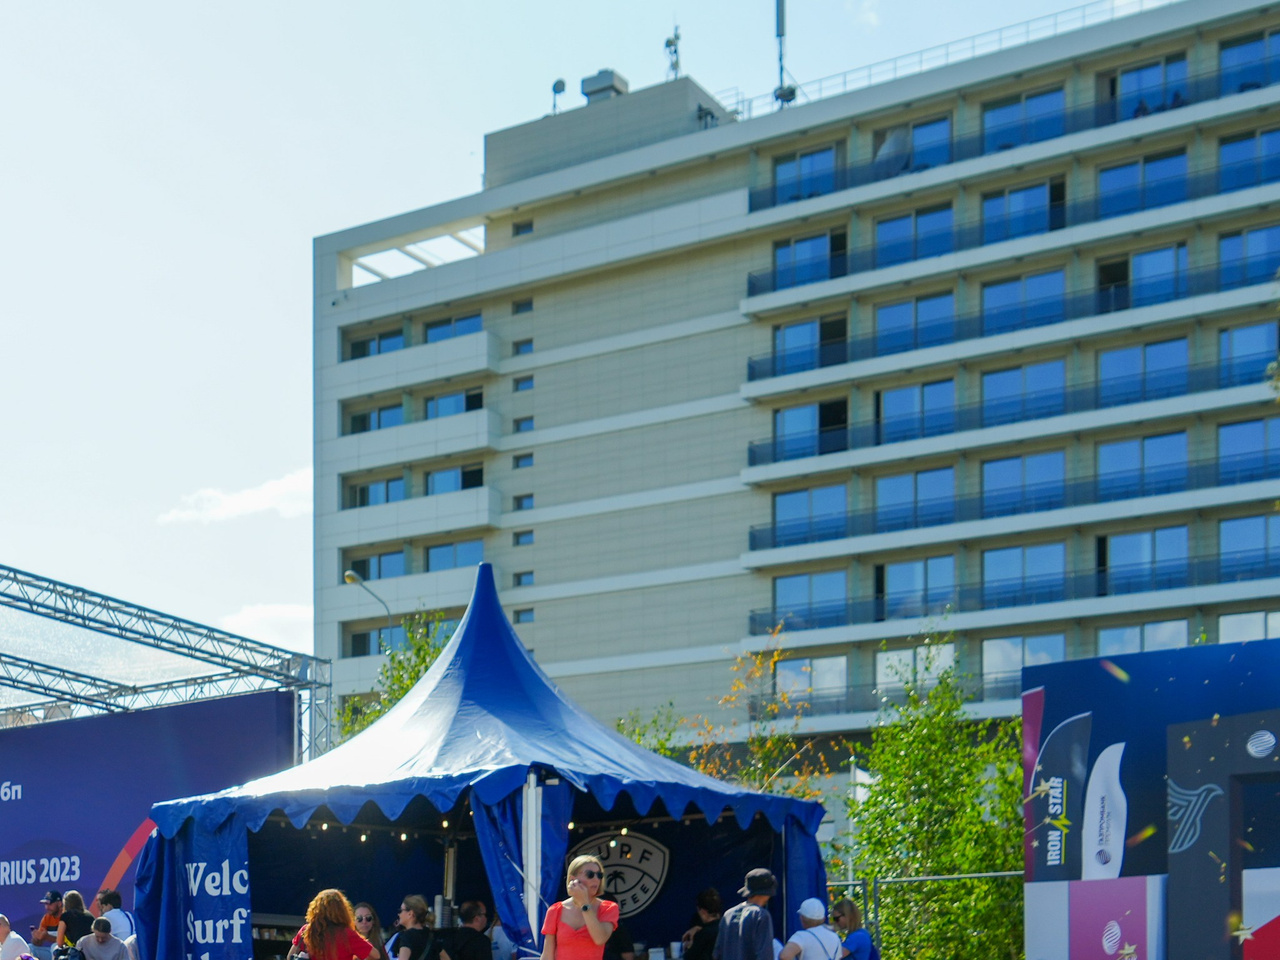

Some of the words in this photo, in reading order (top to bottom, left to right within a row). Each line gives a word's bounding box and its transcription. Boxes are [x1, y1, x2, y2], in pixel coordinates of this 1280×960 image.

[1048, 776, 1063, 815] STAR
[597, 842, 653, 864] URF
[1046, 830, 1061, 866] IRON
[39, 855, 81, 884] 2023
[186, 907, 248, 944] Surf
